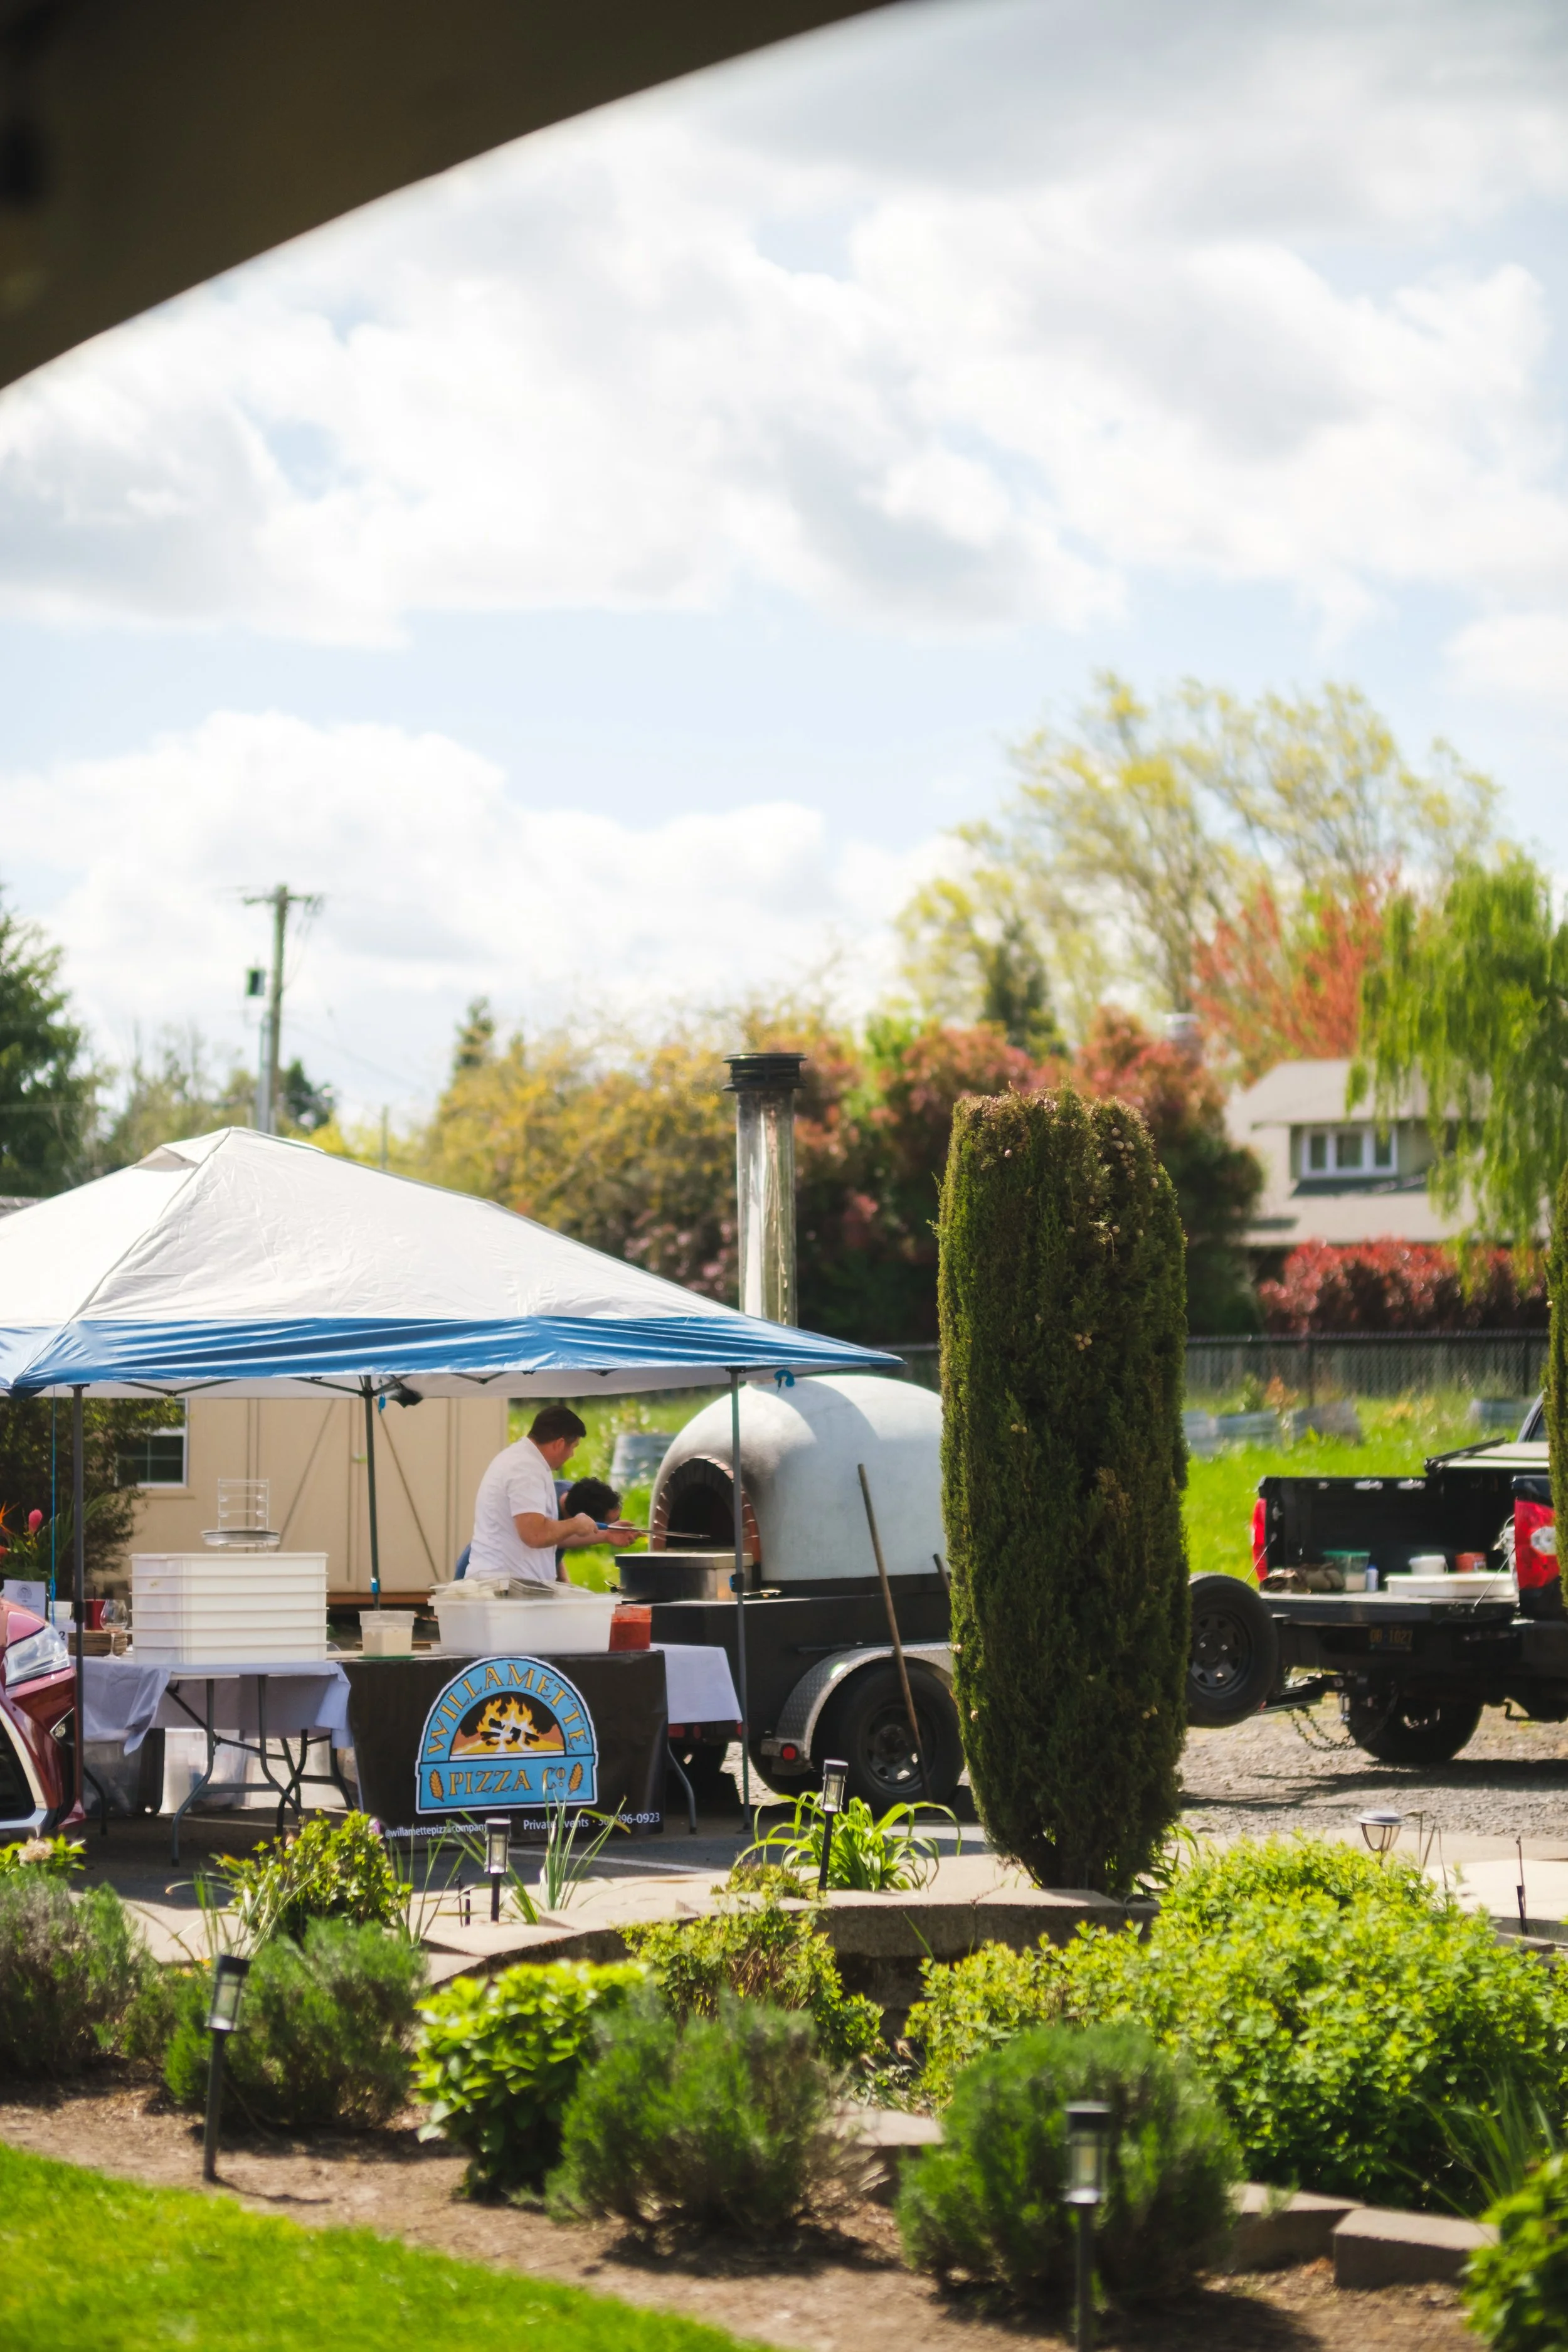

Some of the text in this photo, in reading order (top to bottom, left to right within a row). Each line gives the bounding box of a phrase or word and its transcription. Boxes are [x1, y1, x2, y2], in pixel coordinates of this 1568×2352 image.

[426, 1663, 590, 1755] WILLAMETTE
[449, 1769, 533, 1796] PIZZA
[523, 1819, 556, 1830] Private
[558, 1818, 589, 1828] vents
